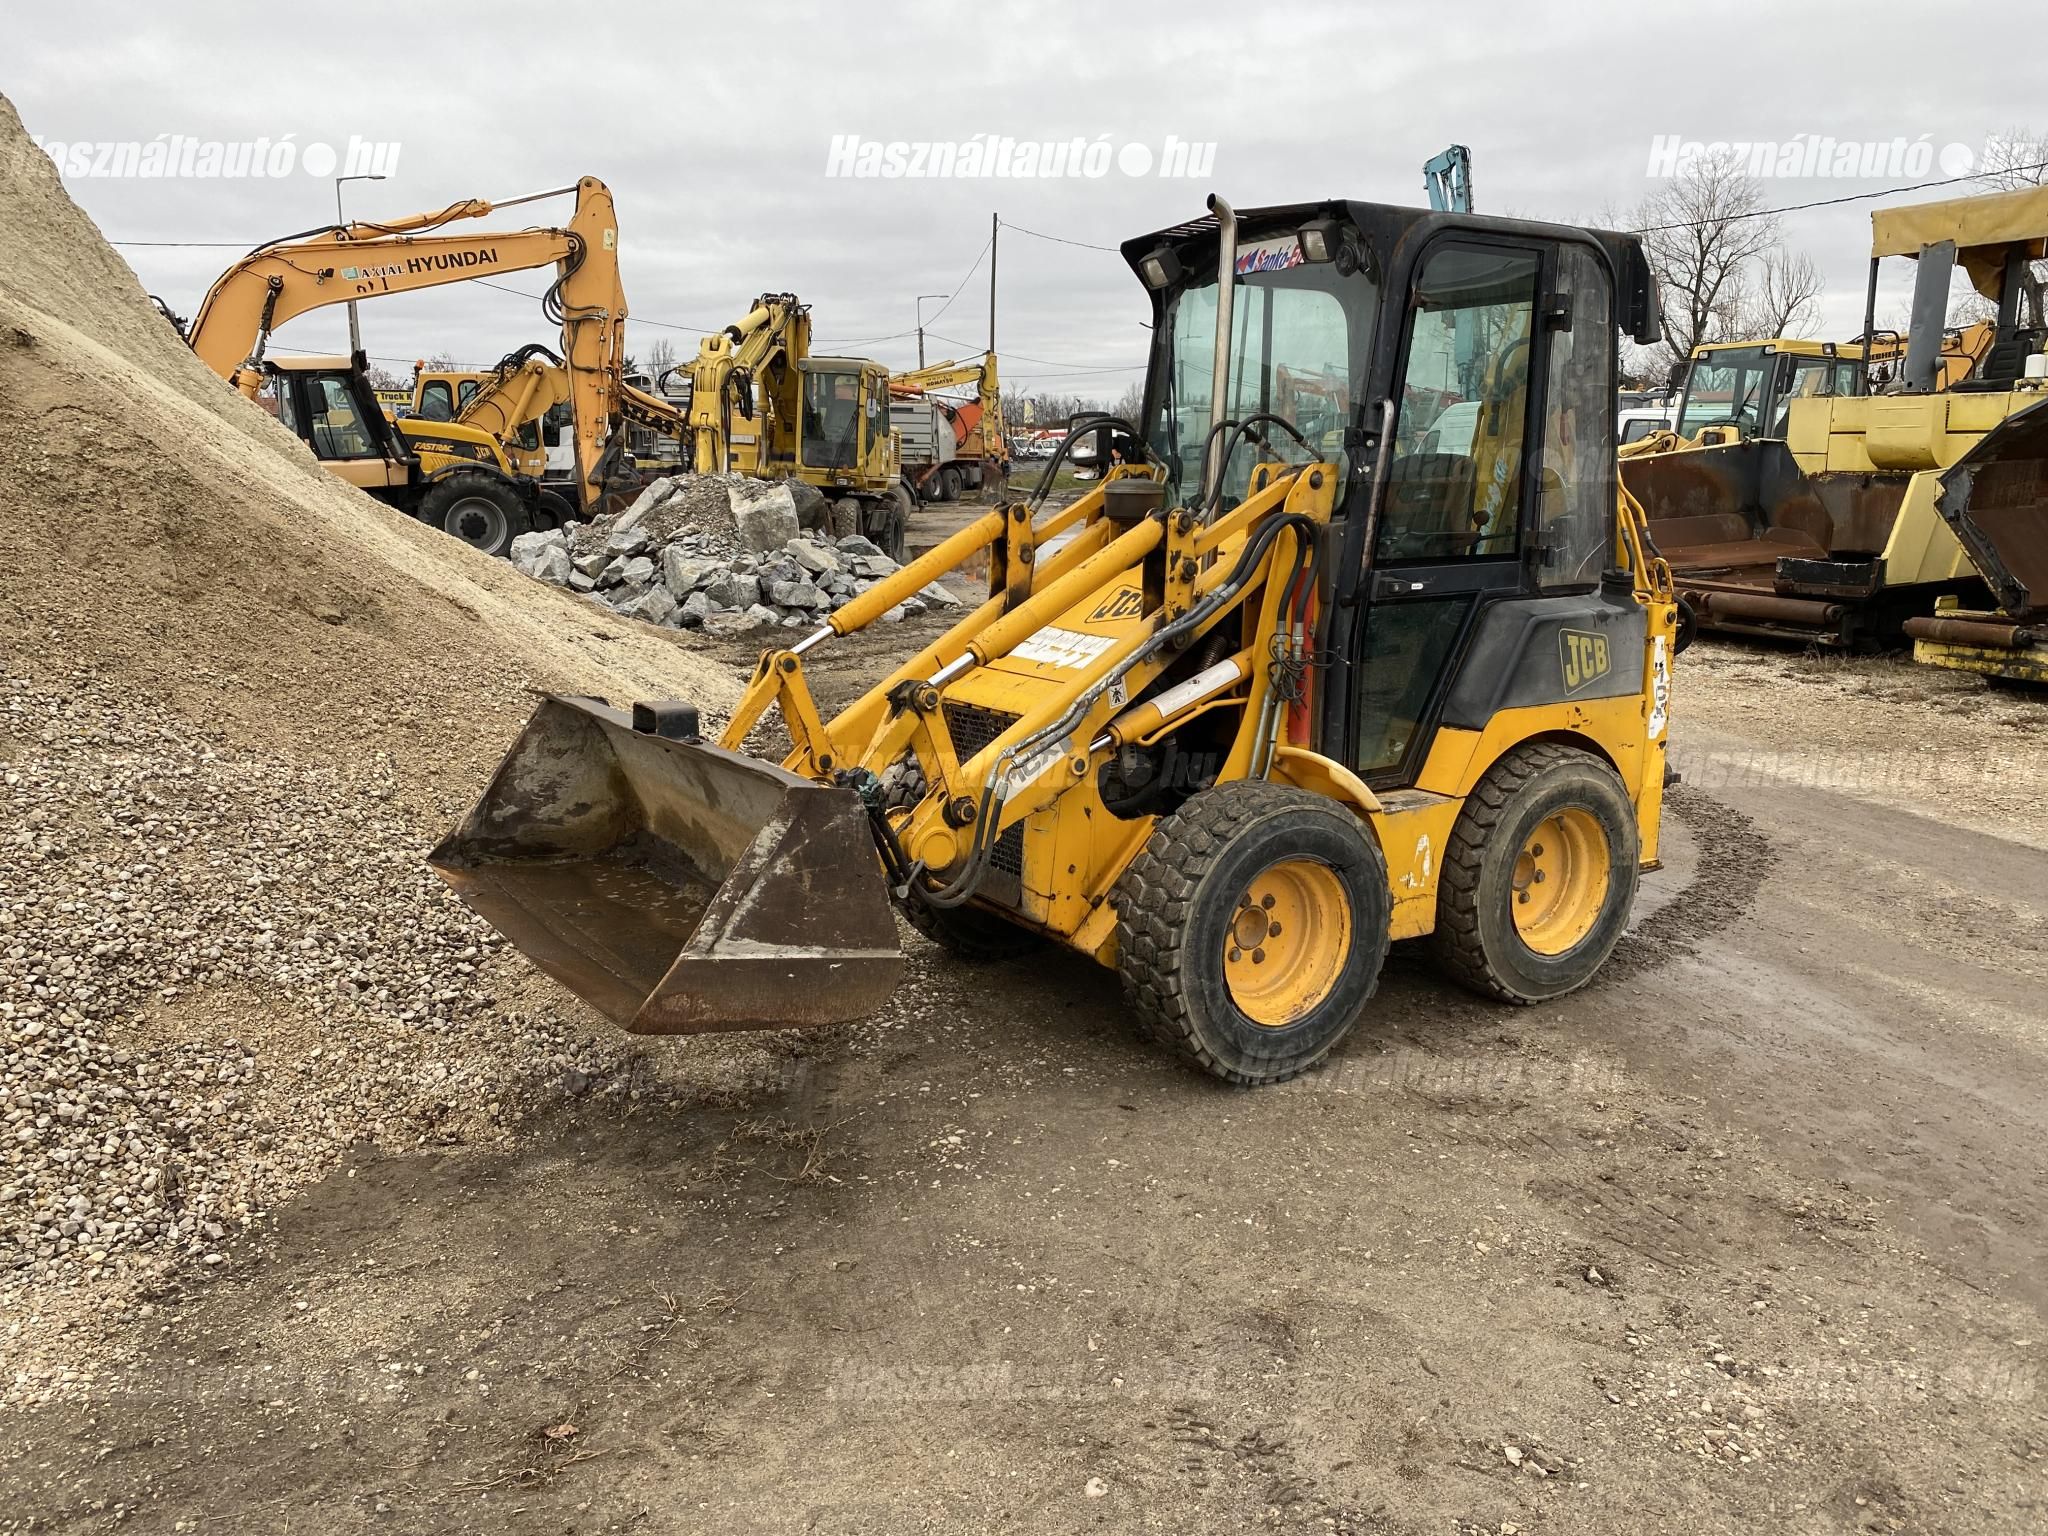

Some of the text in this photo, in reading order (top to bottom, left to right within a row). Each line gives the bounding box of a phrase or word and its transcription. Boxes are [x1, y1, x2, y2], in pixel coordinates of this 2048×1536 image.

[406, 248, 498, 274] HYUNDAI
[381, 392, 404, 400] Truck
[413, 441, 455, 453] FASTRAC
[1566, 635, 1607, 687] JCB
